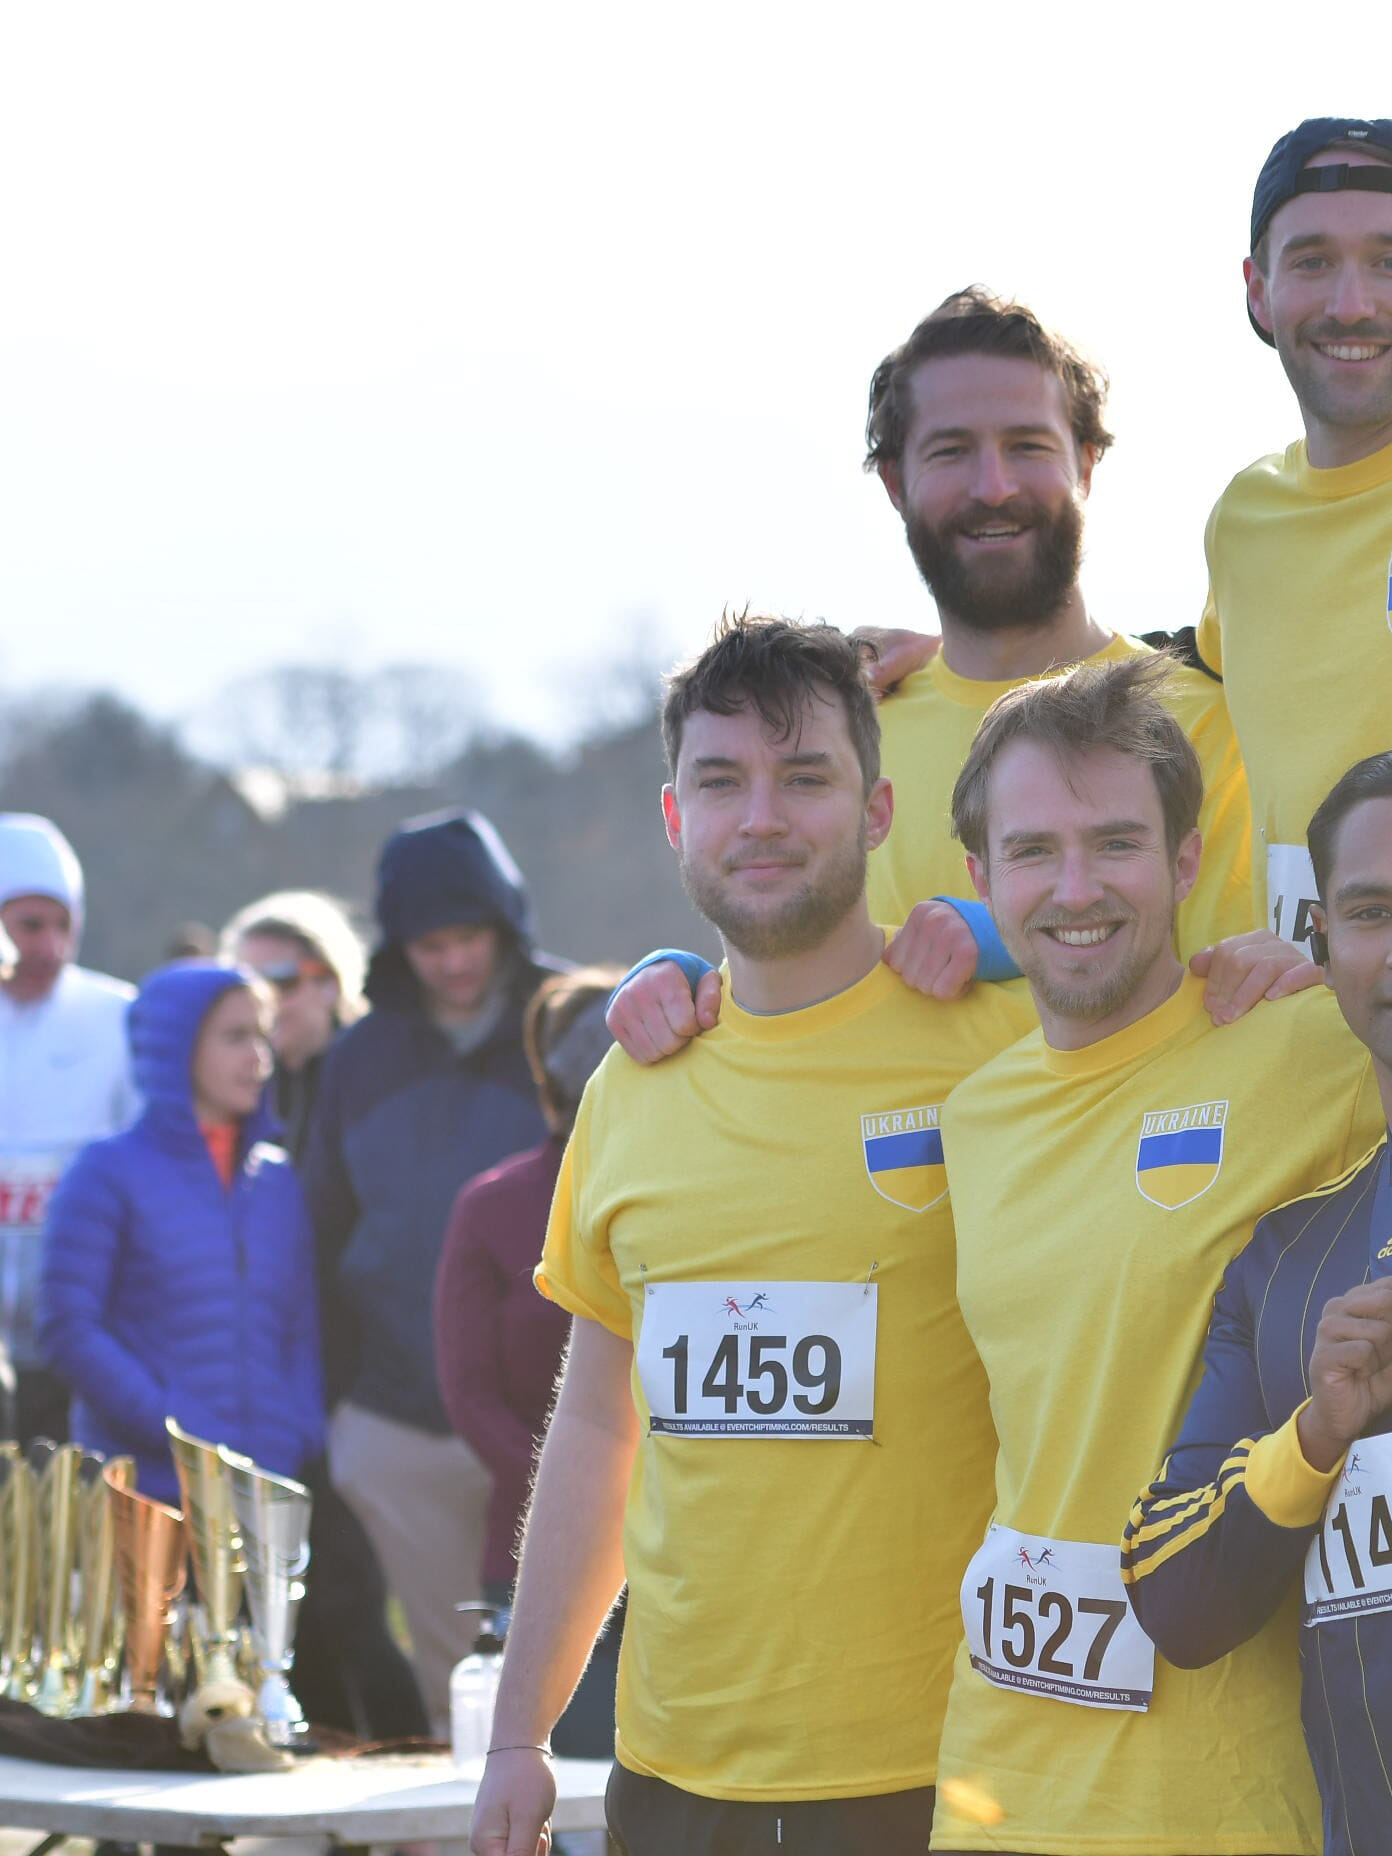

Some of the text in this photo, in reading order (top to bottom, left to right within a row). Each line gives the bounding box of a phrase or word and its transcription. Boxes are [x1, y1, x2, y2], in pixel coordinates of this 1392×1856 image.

[866, 1108, 939, 1136] UKRAIN
[1145, 1104, 1224, 1134] UKRAINE
[733, 1322, 759, 1331] RunUK
[662, 1334, 842, 1415] 1459
[727, 1423, 849, 1432] EVENTCHIPTIMING.COM/RESULTS
[1026, 1574, 1047, 1586] RunUK
[976, 1577, 1127, 1681] 1527
